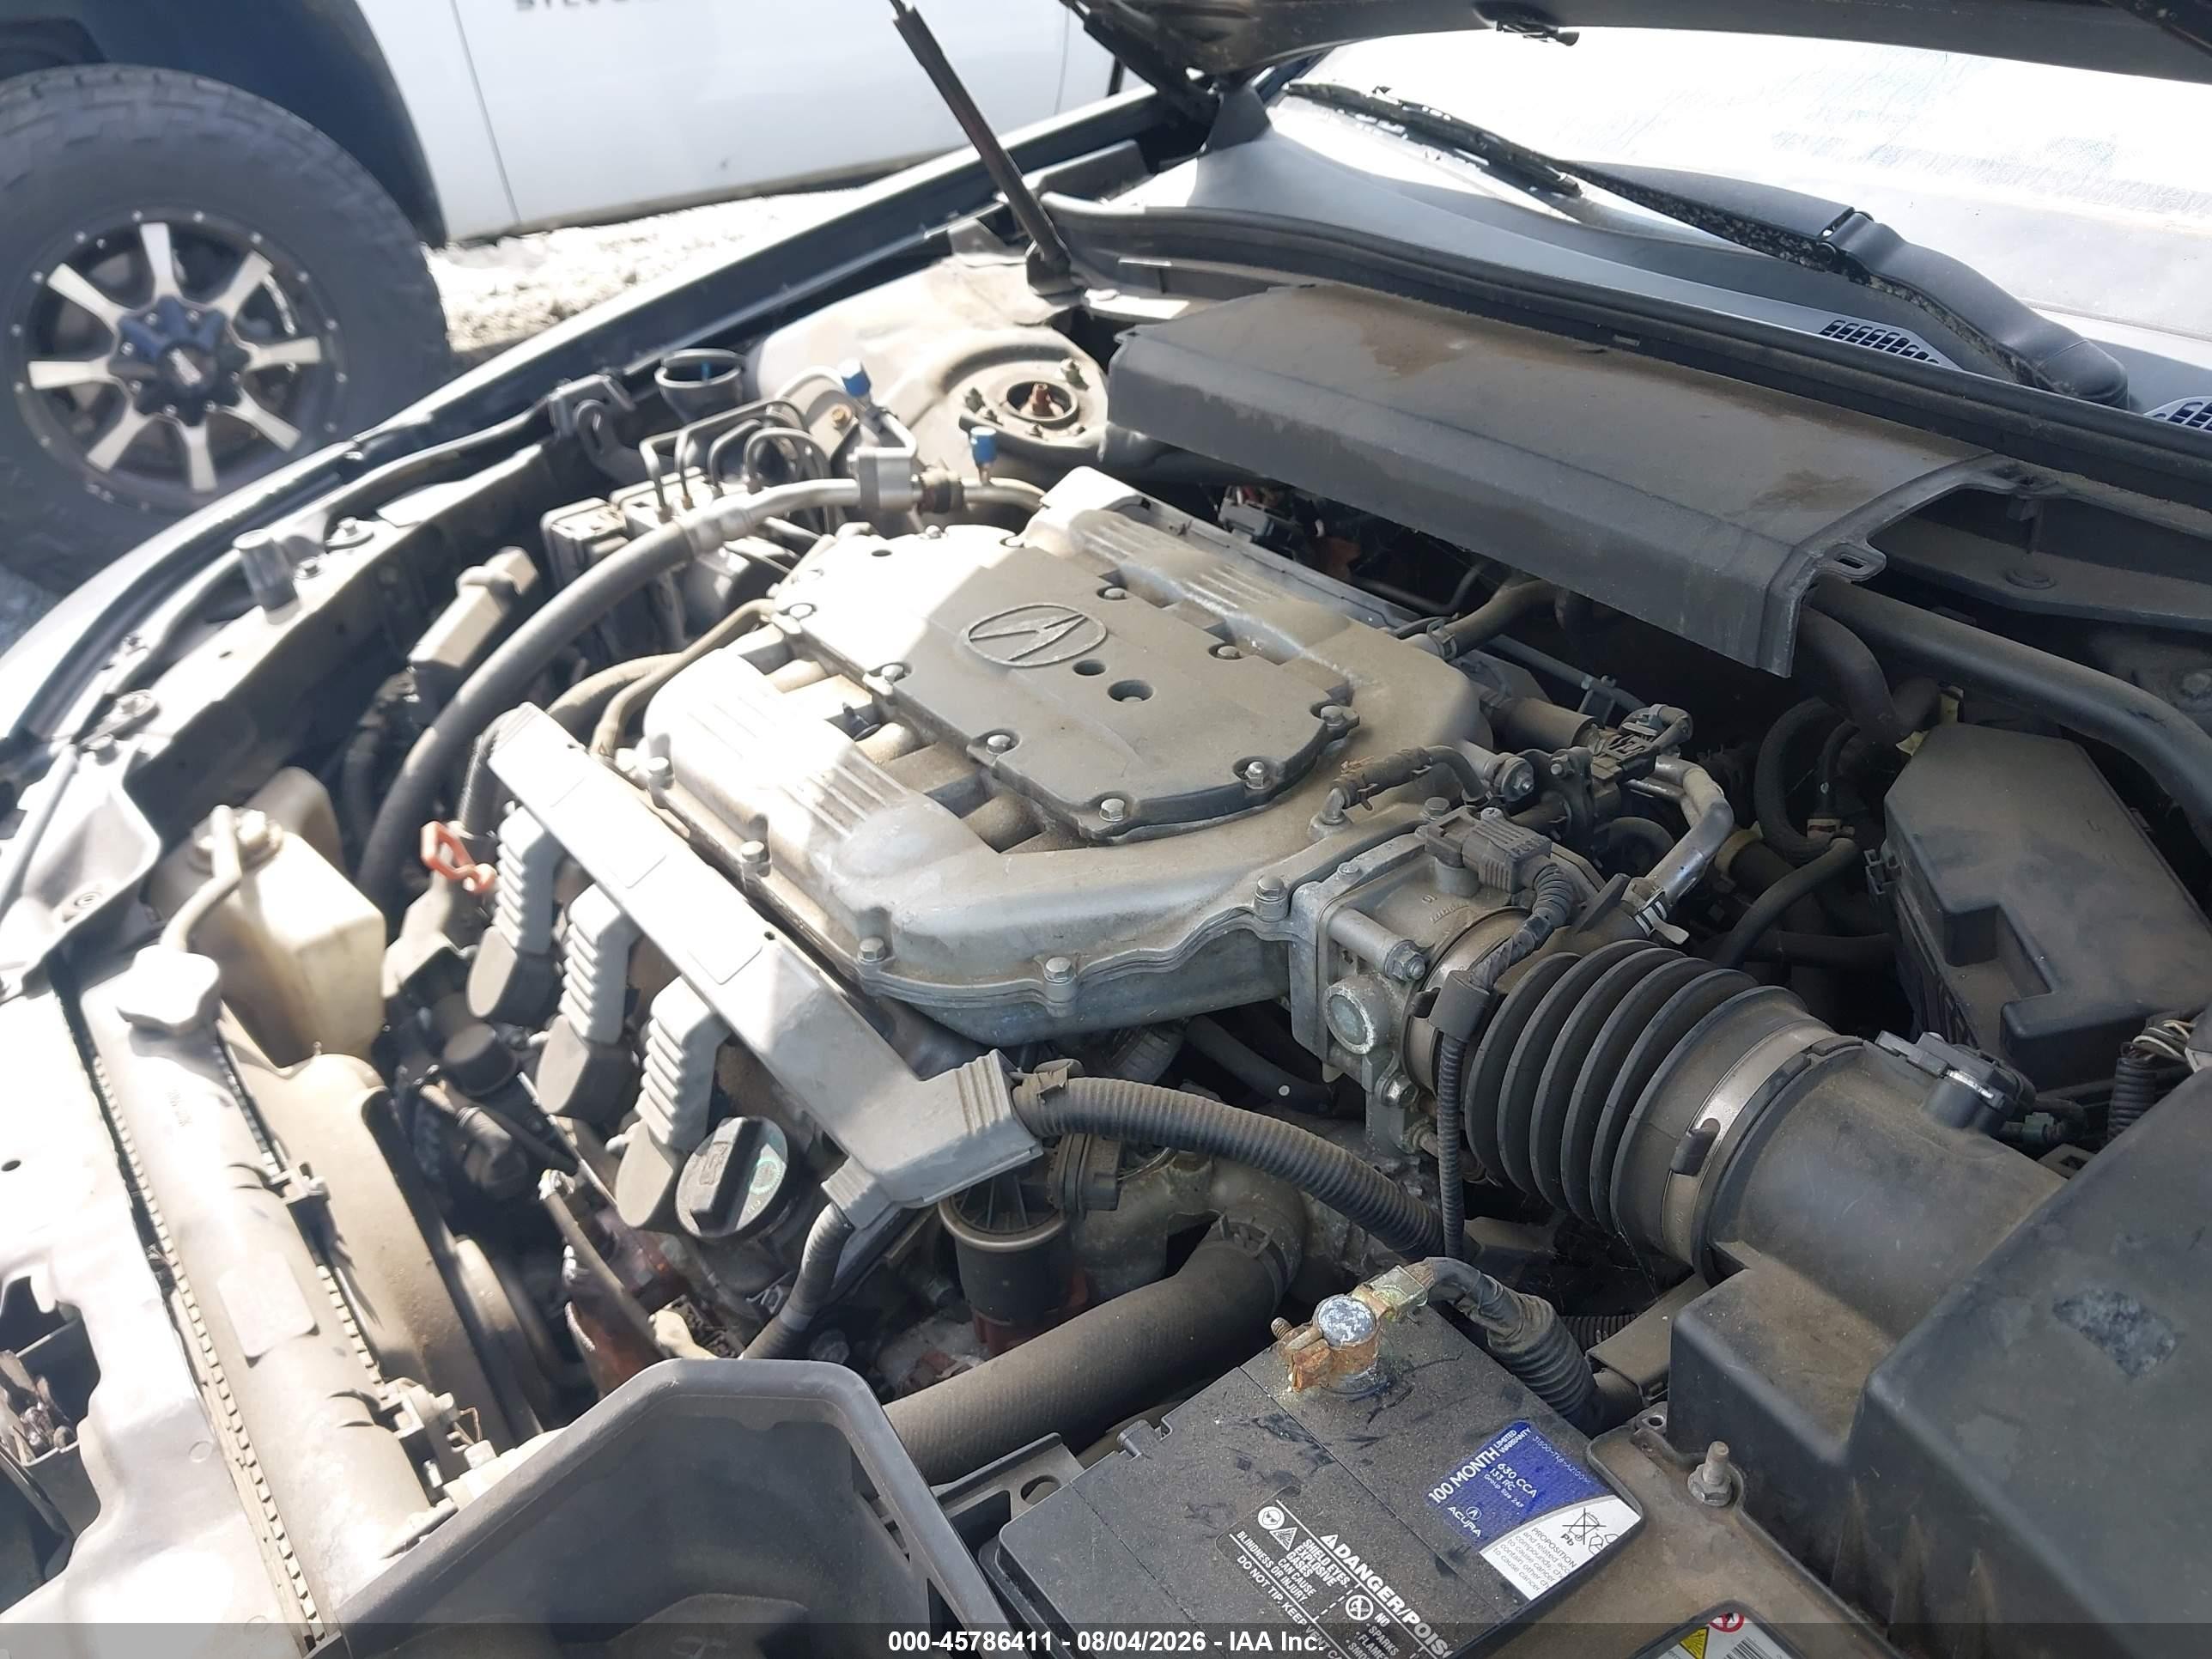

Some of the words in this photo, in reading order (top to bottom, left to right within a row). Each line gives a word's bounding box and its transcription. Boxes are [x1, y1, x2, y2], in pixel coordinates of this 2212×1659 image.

[1492, 1430, 1517, 1449] LIMITED
[1498, 1427, 1532, 1454] WARRANTY
[1428, 1482, 1455, 1504] 100
[1449, 1446, 1501, 1488] MONTH
[1484, 1474, 1501, 1490] Group
[1489, 1468, 1504, 1481] 133
[1502, 1479, 1516, 1492] RC
[1497, 1462, 1517, 1480] 630
[1516, 1478, 1538, 1498] CCA
[1447, 1505, 1482, 1538] ACURA
[1515, 1535, 1553, 1571] compounds,
[1522, 1531, 1537, 1544] and
[1536, 1542, 1559, 1563] related
[1531, 1527, 1578, 1569] PROPOSITION
[1560, 1533, 1575, 1547] Pb
[1236, 1530, 1274, 1569] BLINDNESS
[1270, 1565, 1285, 1578] OR
[1281, 1577, 1309, 1604] INJURY.
[1277, 1558, 1296, 1576] CAN
[1291, 1571, 1316, 1597] CAUSE
[1285, 1551, 1314, 1578] GASES
[1294, 1544, 1337, 1587] EXPLOSIVE
[1302, 1538, 1331, 1565] SHIELD
[1327, 1559, 1351, 1588] EYES.
[1492, 1547, 1502, 1556] to
[1500, 1555, 1520, 1573] cause
[1518, 1571, 1541, 1593] cancer.
[1500, 1544, 1524, 1565] contain
[1522, 1564, 1541, 1580] other
[1507, 1538, 1516, 1547] to
[1515, 1547, 1534, 1564] cause
[1533, 1562, 1556, 1583] cancer
[1237, 1554, 1252, 1570] DO
[1249, 1567, 1272, 1589] NOT
[1267, 1585, 1284, 1604] TIP.
[1281, 1601, 1308, 1626] KEEP
[1374, 1612, 1391, 1628] NO
[1368, 1625, 1400, 1656] SPARKS
